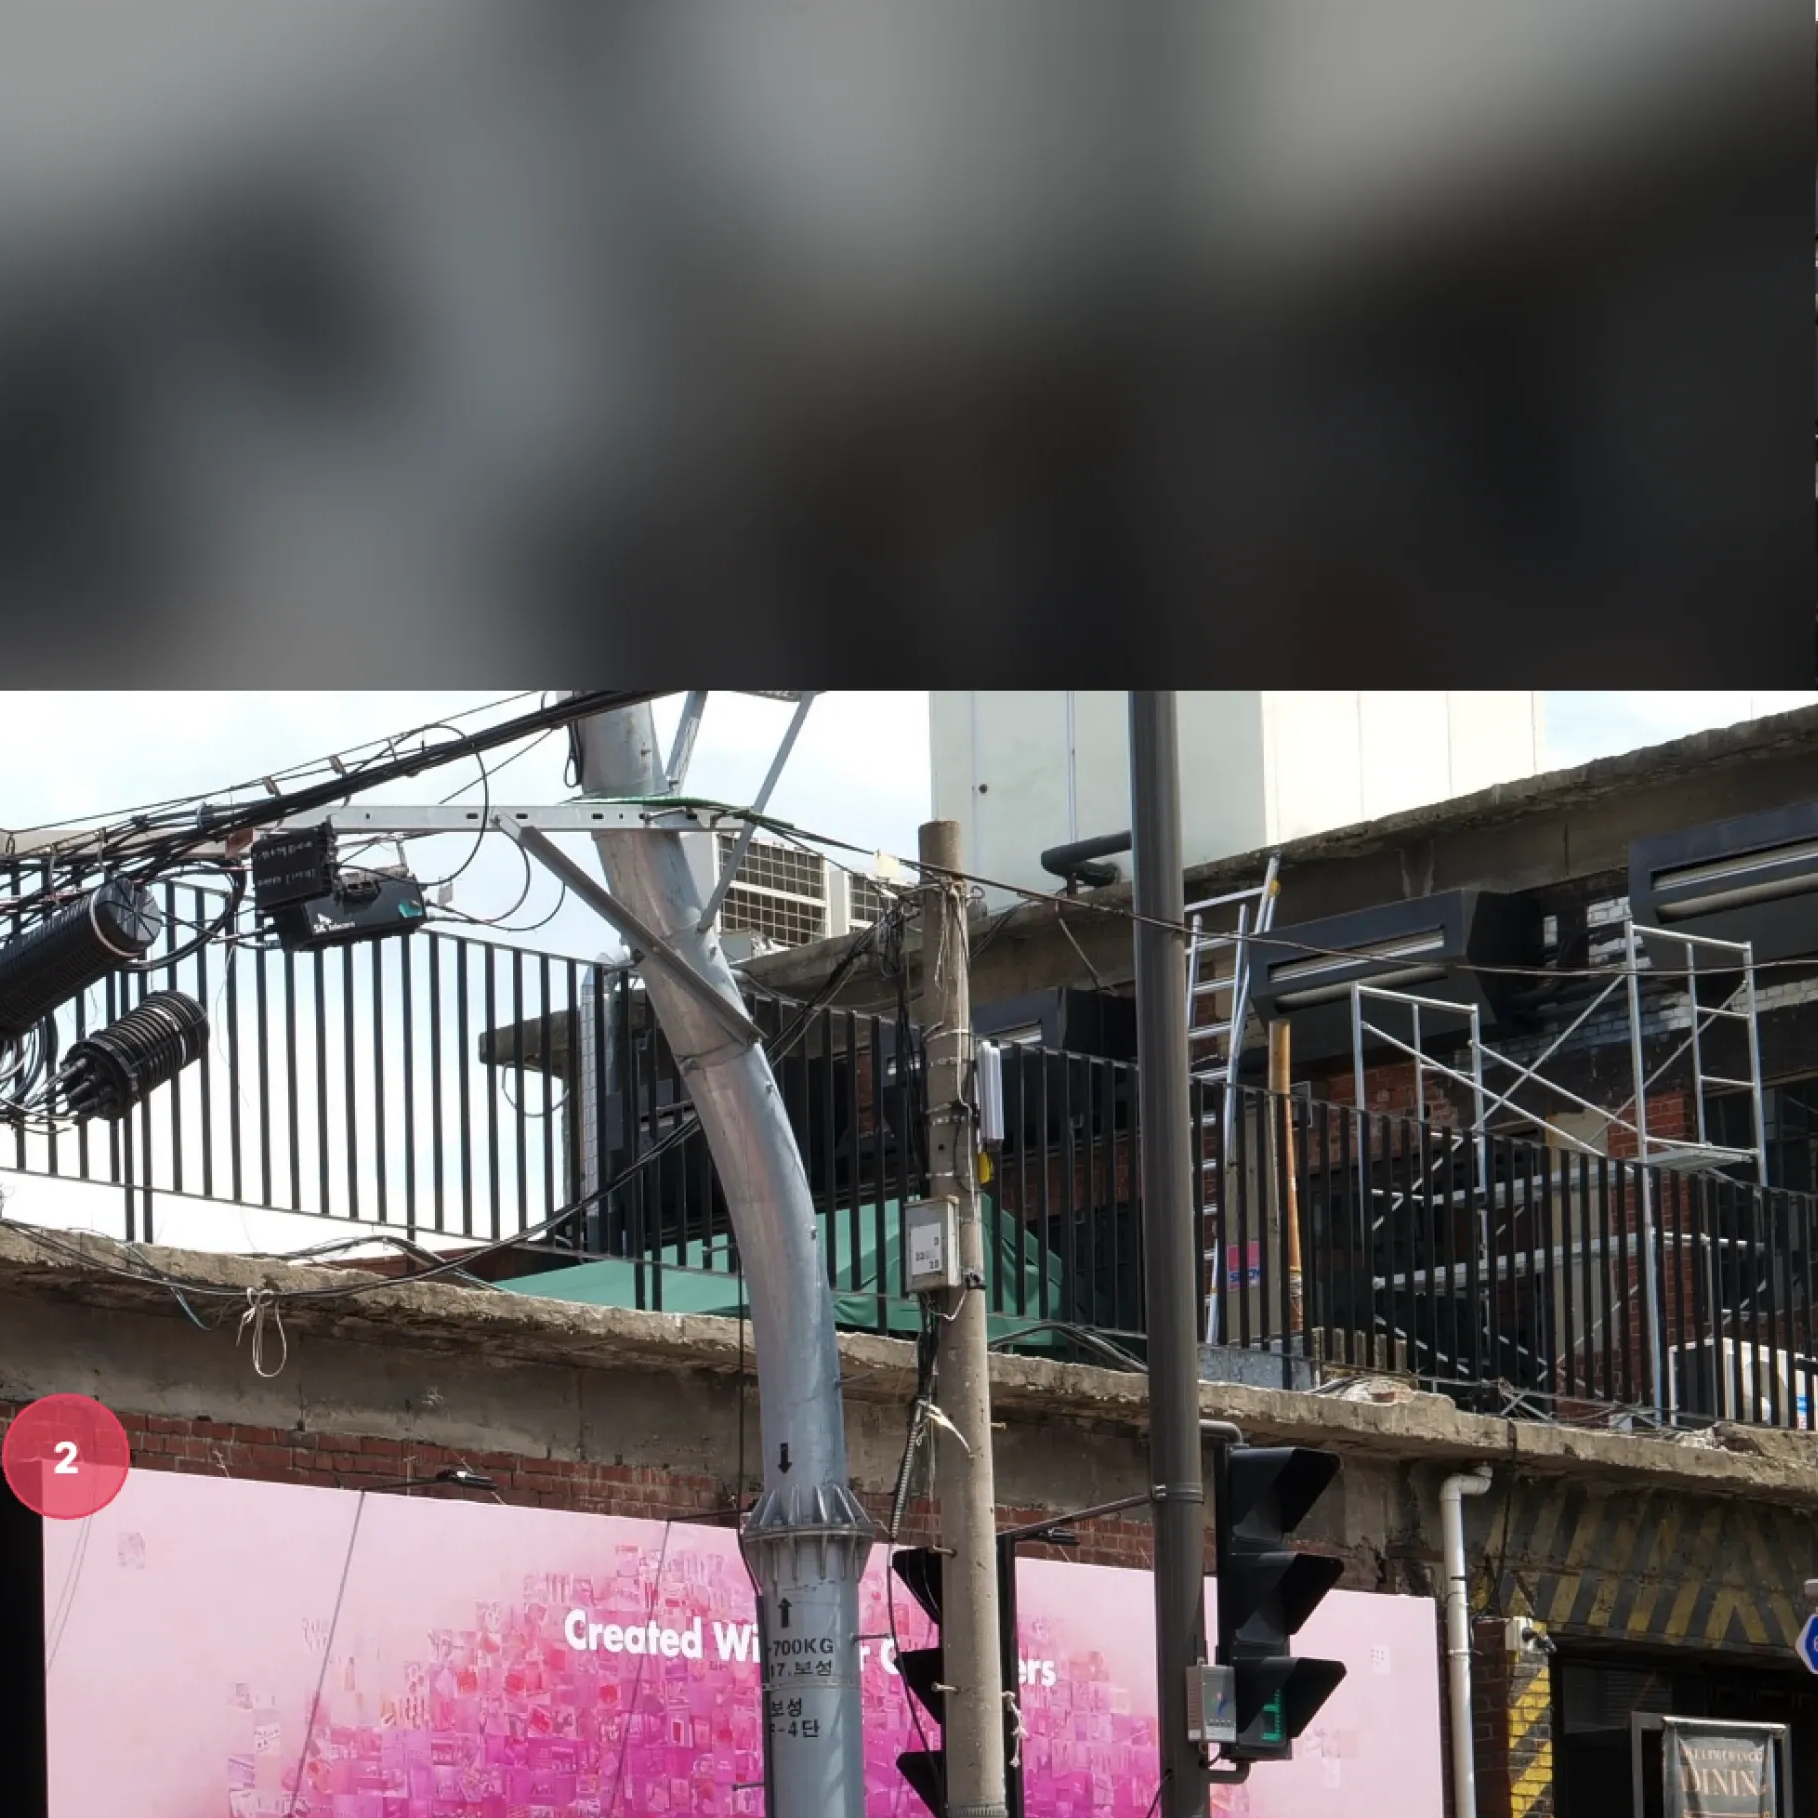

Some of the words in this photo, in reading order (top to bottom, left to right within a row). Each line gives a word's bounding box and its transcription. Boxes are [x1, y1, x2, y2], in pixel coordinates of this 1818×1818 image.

[564, 1609, 702, 1660] Created
[715, 1622, 761, 1664] Wi
[770, 1697, 803, 1718] 보성
[1682, 1767, 1768, 1797] DININ
